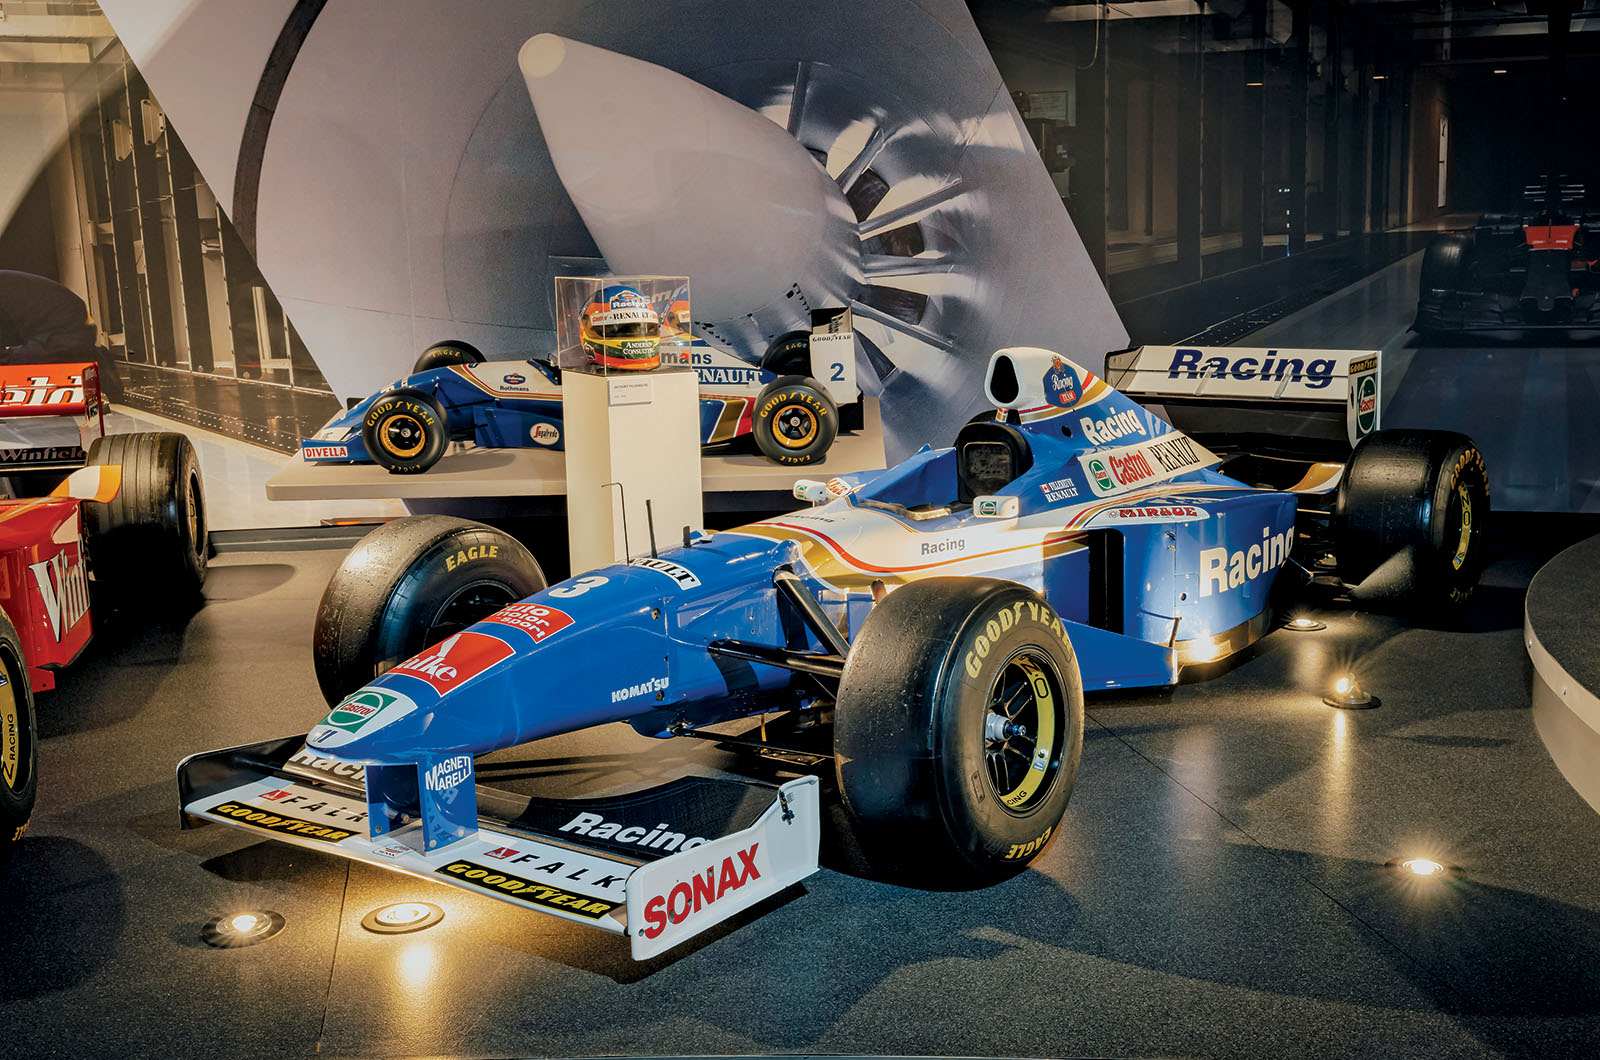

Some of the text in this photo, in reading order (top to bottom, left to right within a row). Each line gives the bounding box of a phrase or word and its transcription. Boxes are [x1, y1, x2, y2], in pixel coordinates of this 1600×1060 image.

[812, 333, 852, 342] GOODYEAR
[830, 362, 845, 382] 2
[1168, 349, 1337, 389] Racing
[366, 400, 435, 427] GOODYEAR
[760, 391, 828, 418] GOODYEAR
[1080, 407, 1147, 446] Racing
[305, 446, 348, 458] DIVELLA
[1109, 436, 1200, 486] Castrol RENAULT
[1045, 487, 1079, 503] RENAULT
[446, 544, 499, 573] EAGLE
[921, 537, 966, 556] Racing
[1199, 525, 1295, 598] Racing
[548, 576, 609, 598] 3
[964, 601, 1073, 679] GOODYEAR
[340, 702, 376, 716] Castrol
[216, 804, 350, 840] GOODYEAR
[1004, 825, 1052, 859] EAGLE
[446, 863, 612, 915] GOODYEAR
[643, 842, 761, 940] SONAX
